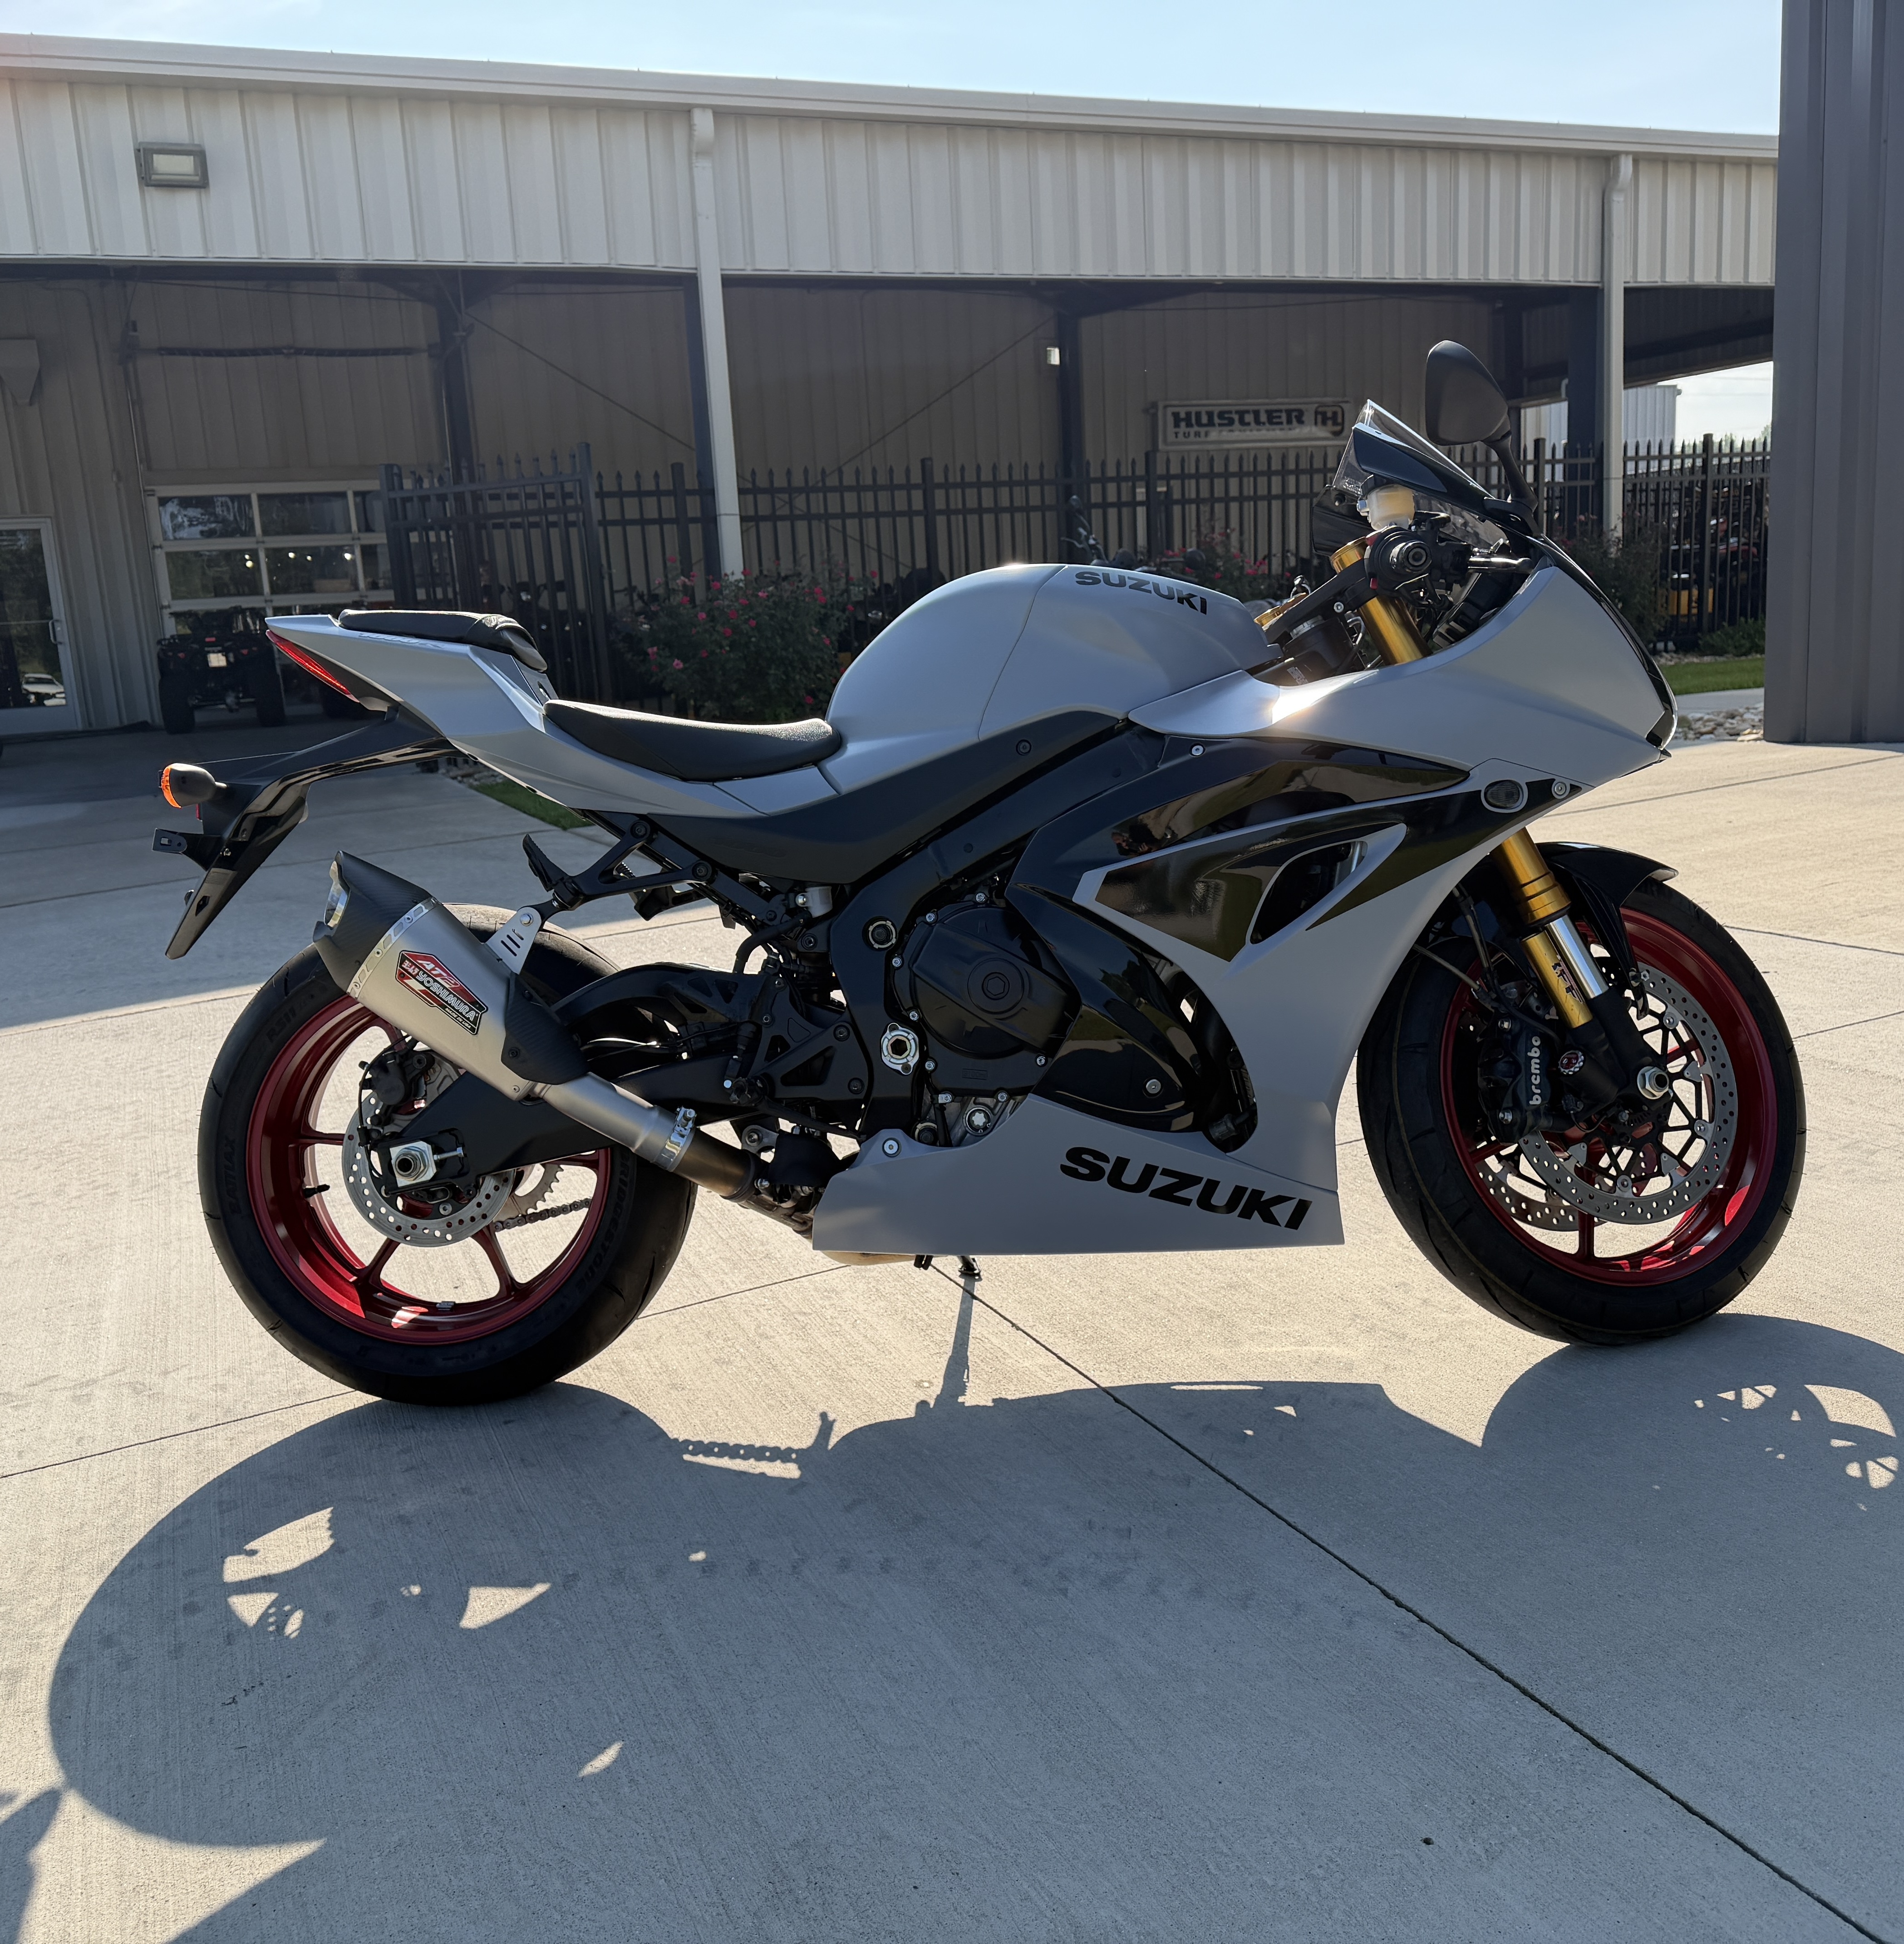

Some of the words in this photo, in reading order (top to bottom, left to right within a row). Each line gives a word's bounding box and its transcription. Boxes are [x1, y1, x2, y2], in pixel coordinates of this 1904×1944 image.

[1171, 409, 1304, 428] HUSTLER
[1174, 431, 1210, 439] TURF
[1075, 571, 1207, 615] SUZUKI
[416, 971, 476, 1021] YOSHIMURA
[1527, 1036, 1541, 1105] brembo
[1060, 1147, 1313, 1231] SUZUKI
